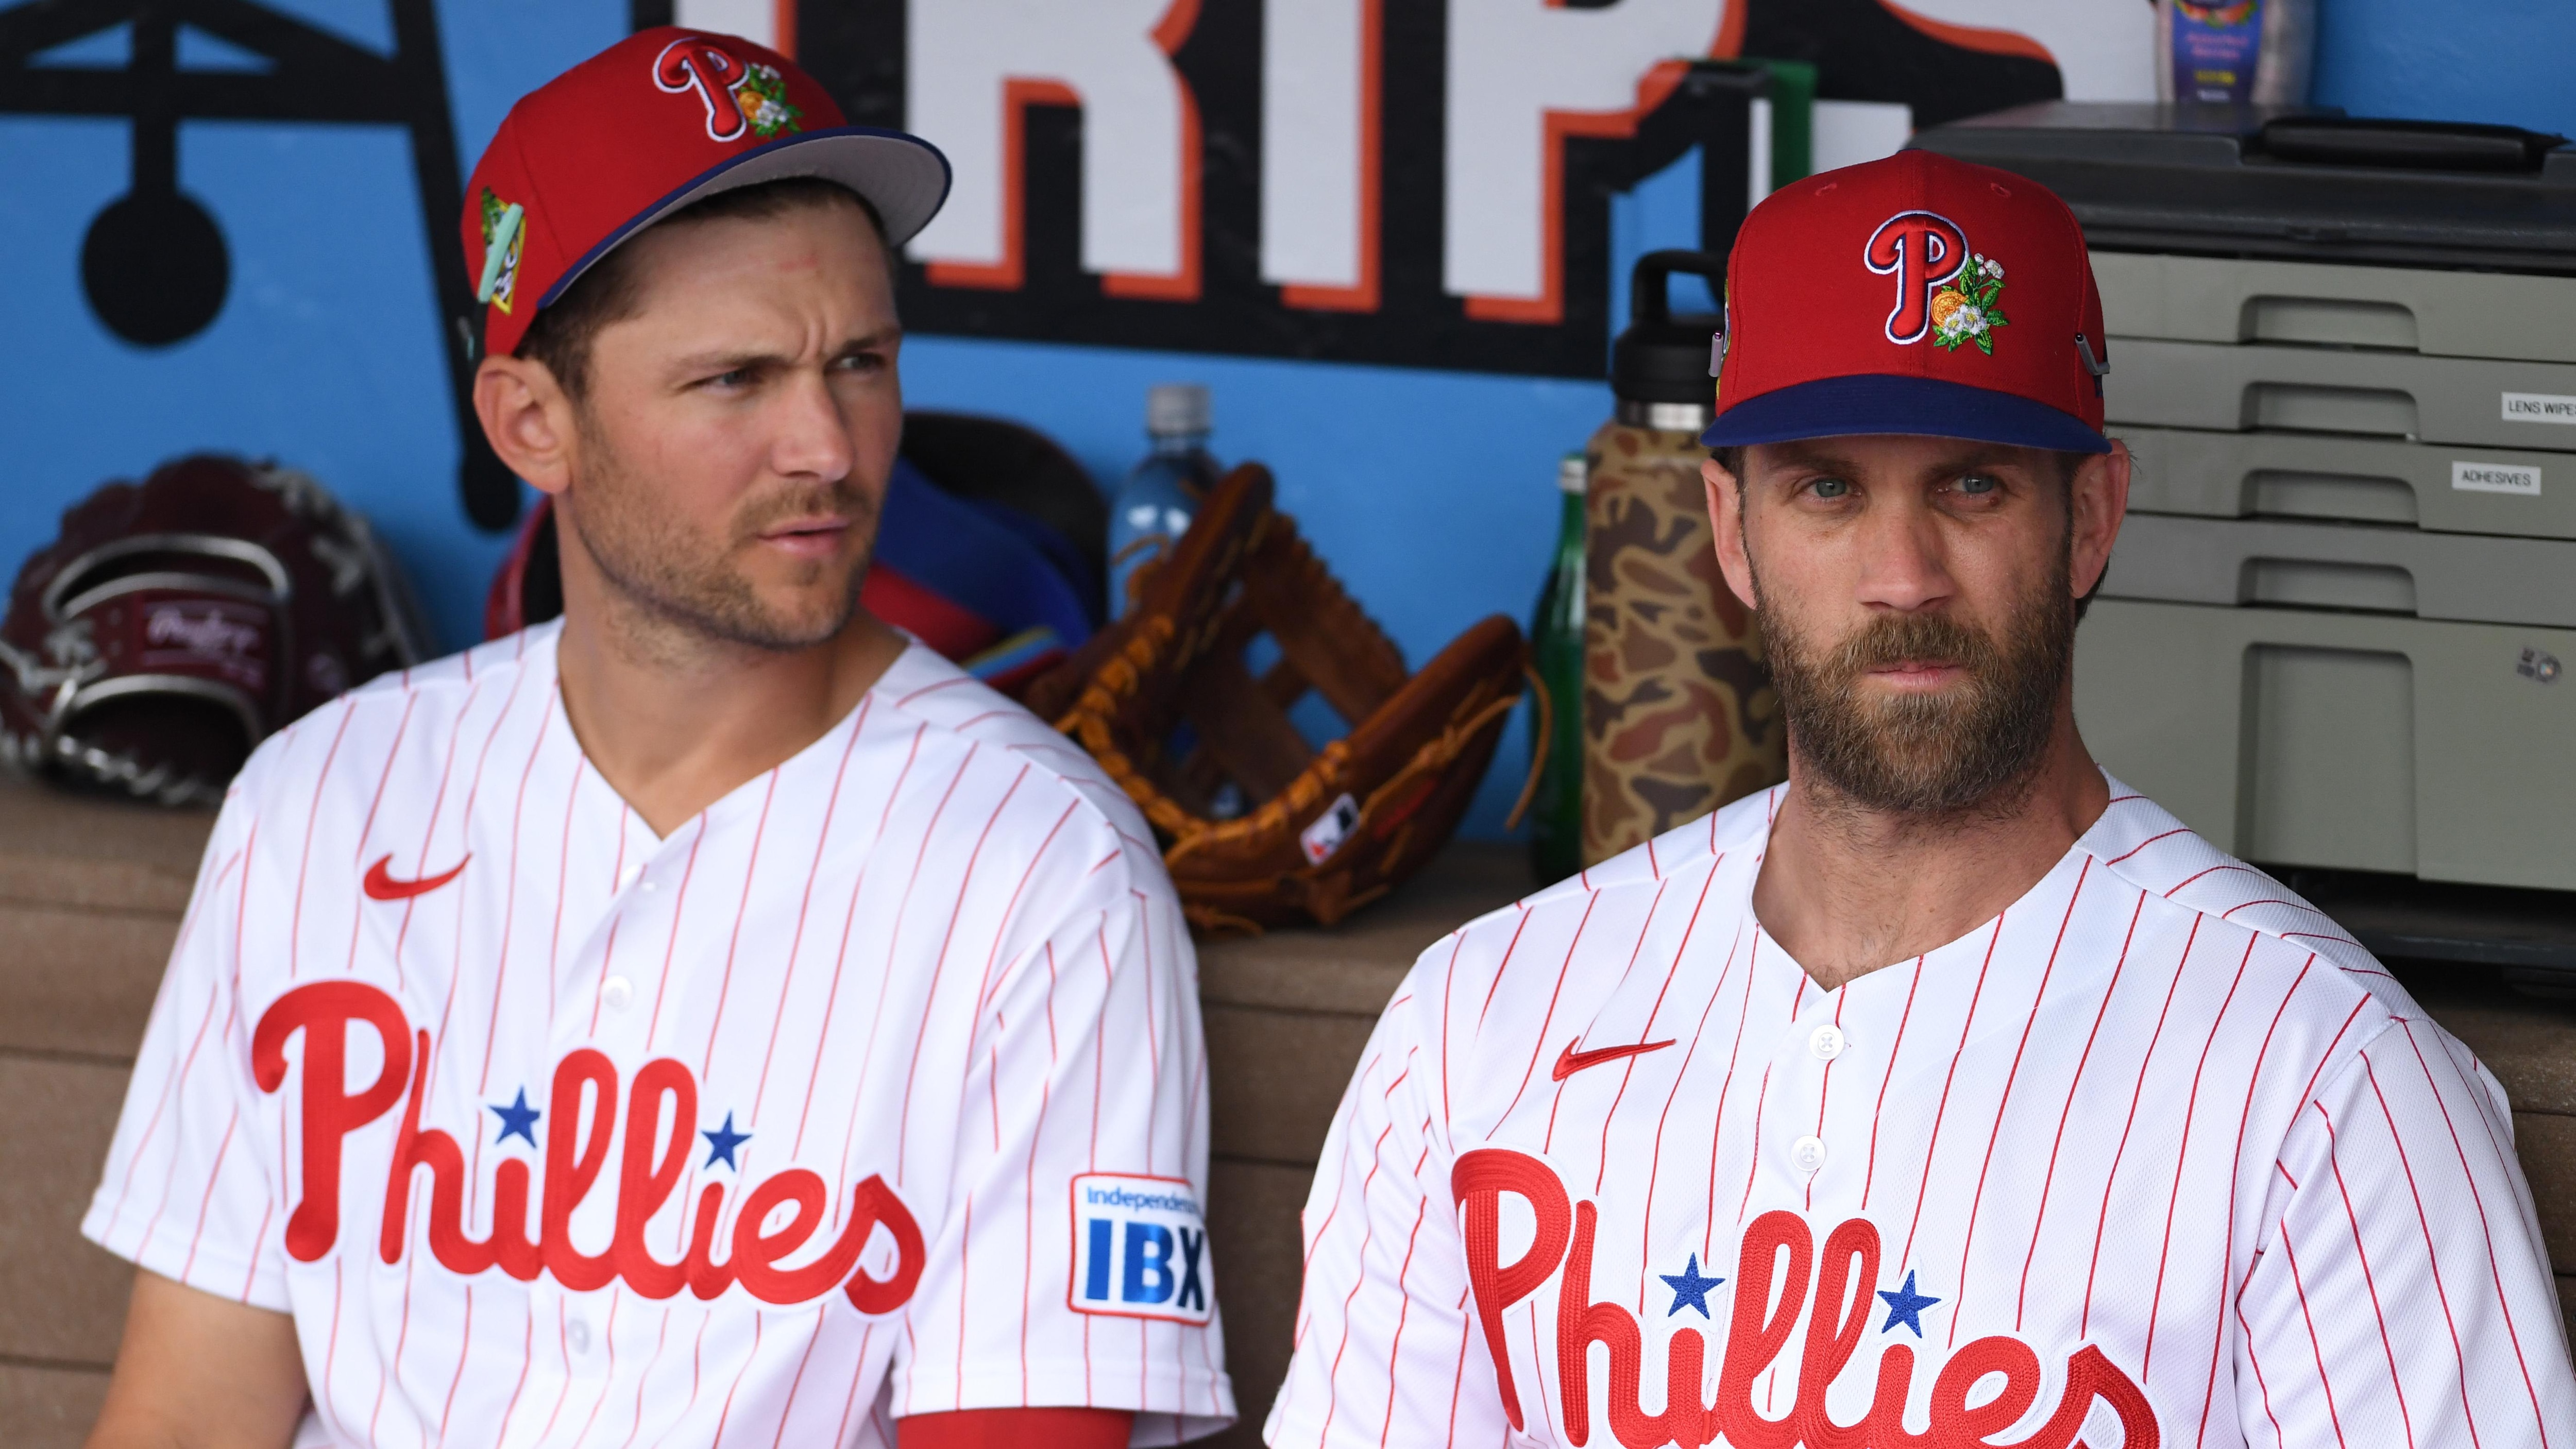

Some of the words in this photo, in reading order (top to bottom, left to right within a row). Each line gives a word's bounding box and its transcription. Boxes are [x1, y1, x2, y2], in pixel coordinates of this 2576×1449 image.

[652, 36, 750, 143] P
[1864, 210, 1969, 345] P
[2509, 400, 2540, 414] LENS
[2544, 402, 2576, 416] WIPE
[2462, 469, 2531, 487] ADHESIVES
[252, 980, 926, 1315] Phillies
[1086, 1218, 1205, 1311] IBX
[1451, 1148, 2161, 1449] Phillies
